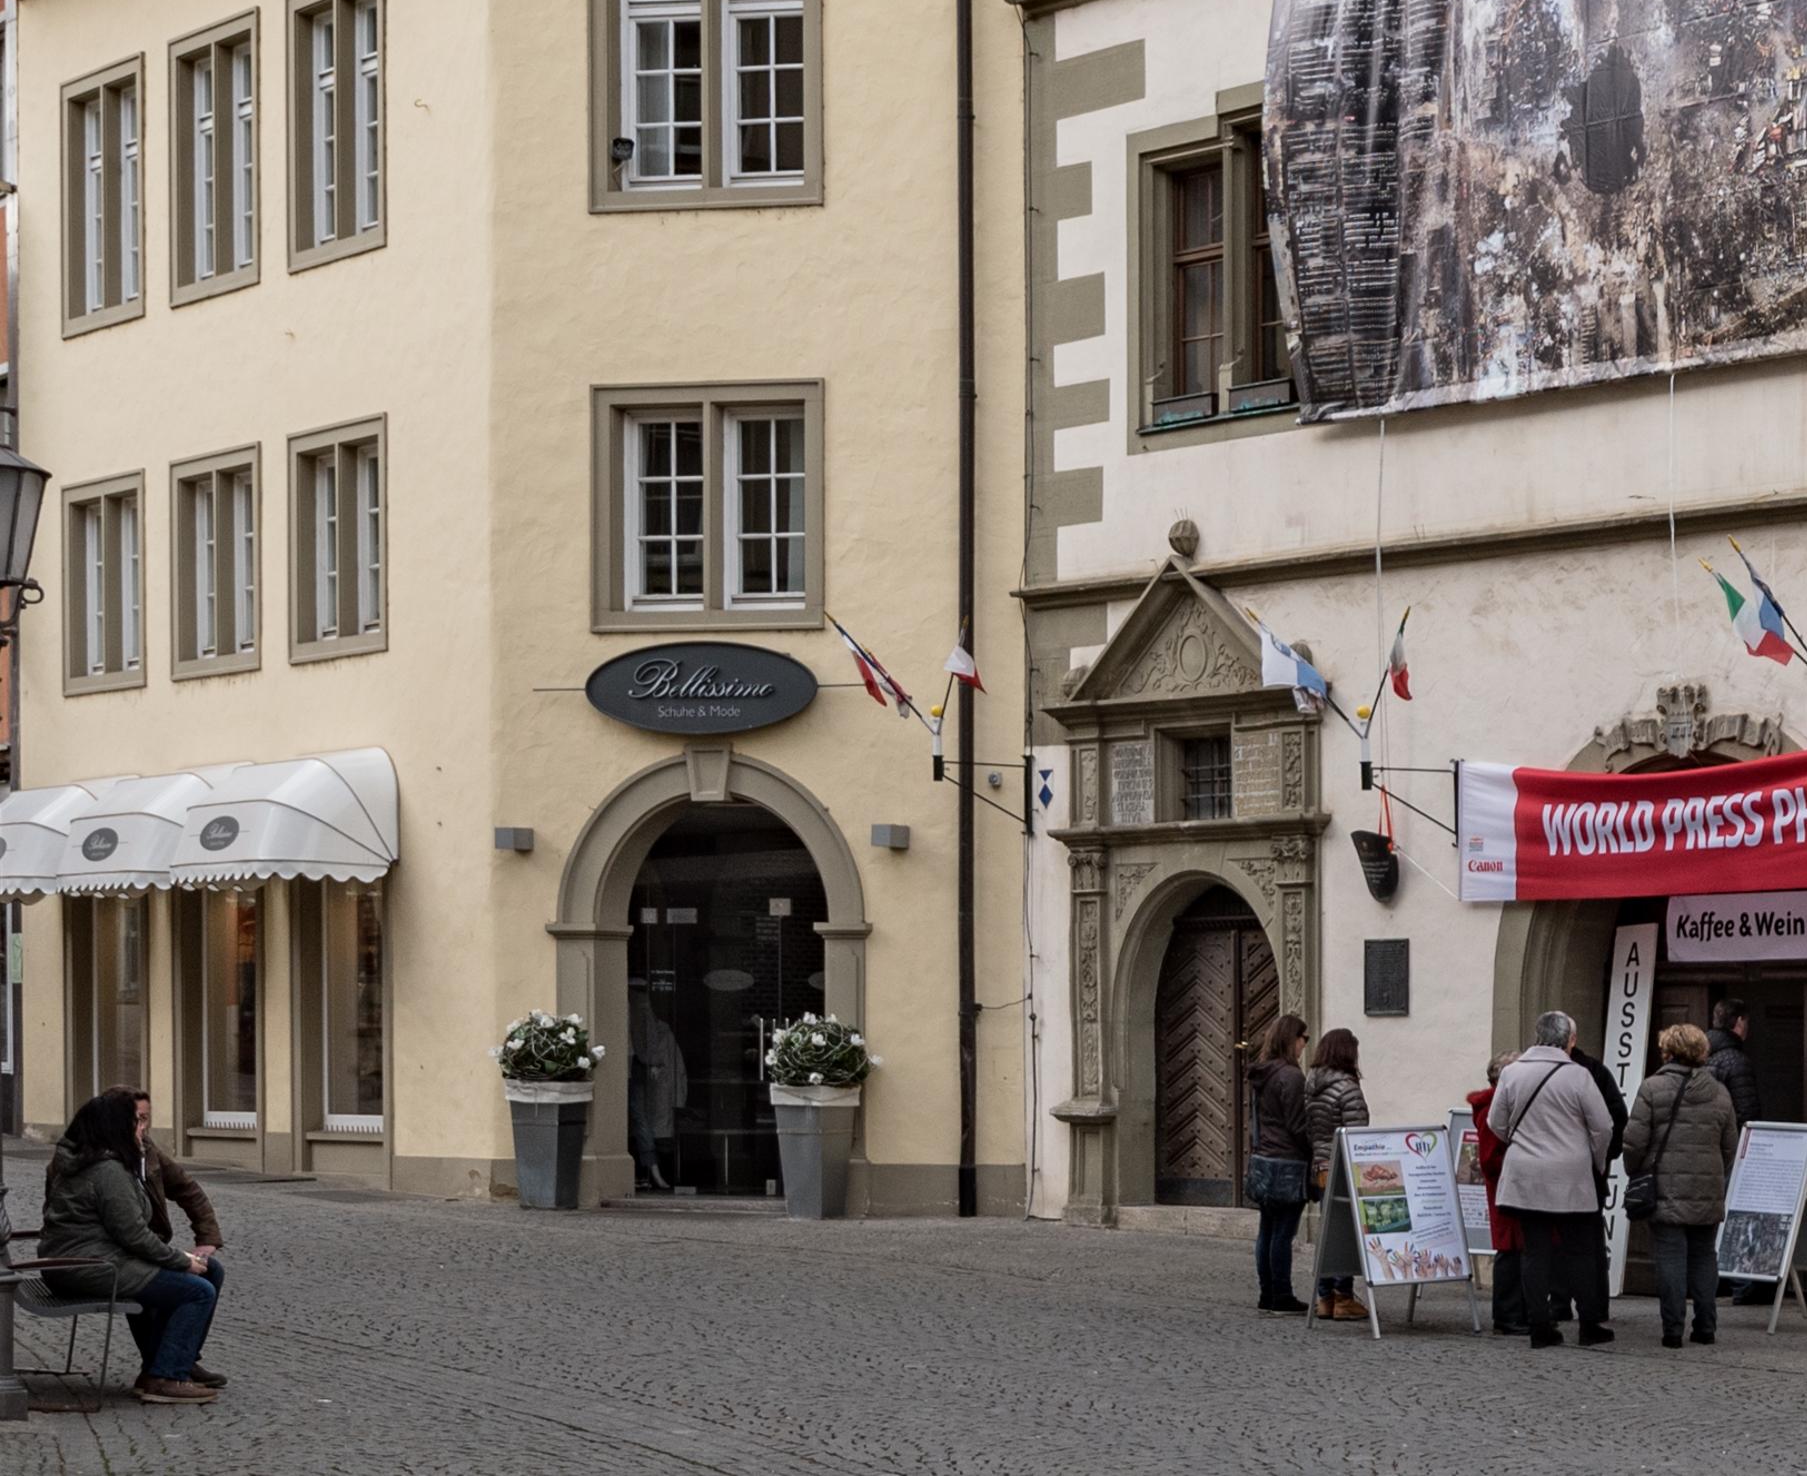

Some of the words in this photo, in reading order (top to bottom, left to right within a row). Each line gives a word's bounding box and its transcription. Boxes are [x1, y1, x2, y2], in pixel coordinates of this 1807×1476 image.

[629, 658, 774, 699] Bellissimo
[658, 706, 696, 718] Schuhe
[699, 706, 706, 717] &
[710, 706, 740, 717] Mode
[1542, 801, 1656, 856] WORLD
[1664, 791, 1764, 851] PRESS
[1468, 859, 1504, 873] Canon
[1676, 914, 1736, 943] Kaffee
[1739, 914, 1753, 937] &
[1754, 911, 1805, 938] Wein
